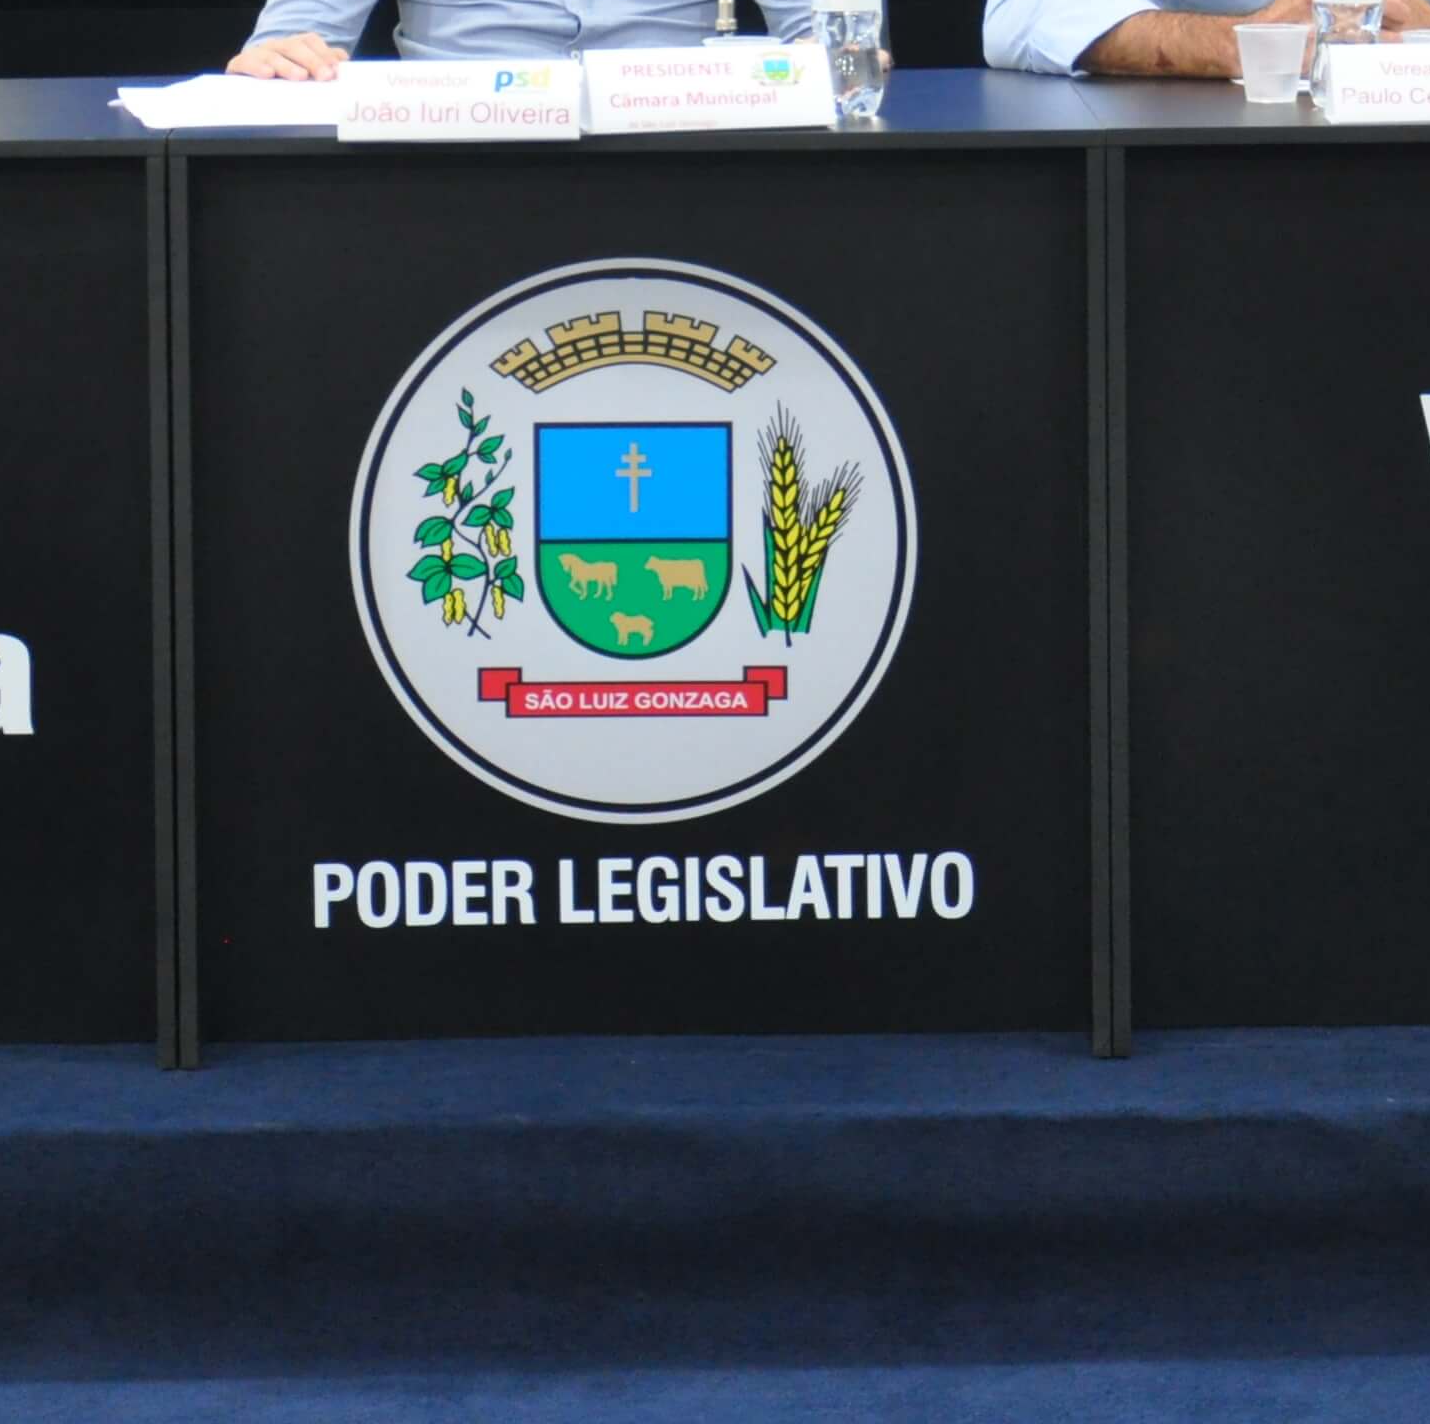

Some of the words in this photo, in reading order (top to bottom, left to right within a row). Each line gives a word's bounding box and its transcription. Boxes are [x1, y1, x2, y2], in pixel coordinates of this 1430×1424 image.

[386, 72, 469, 88] Vereador
[494, 66, 552, 93] psd
[621, 62, 734, 78] PRESIDENTE
[610, 91, 680, 109] Câmara
[685, 90, 779, 108] Municipal
[1341, 87, 1403, 105] Paulo
[346, 101, 411, 124] João
[420, 102, 460, 124] Iuri
[470, 101, 570, 125] Oliveira
[524, 689, 573, 710] SÃO
[578, 691, 626, 710] LUIZ
[634, 691, 748, 709] GONZAGA
[313, 859, 537, 929] PODER
[558, 851, 974, 926] LEGISLATIVO
